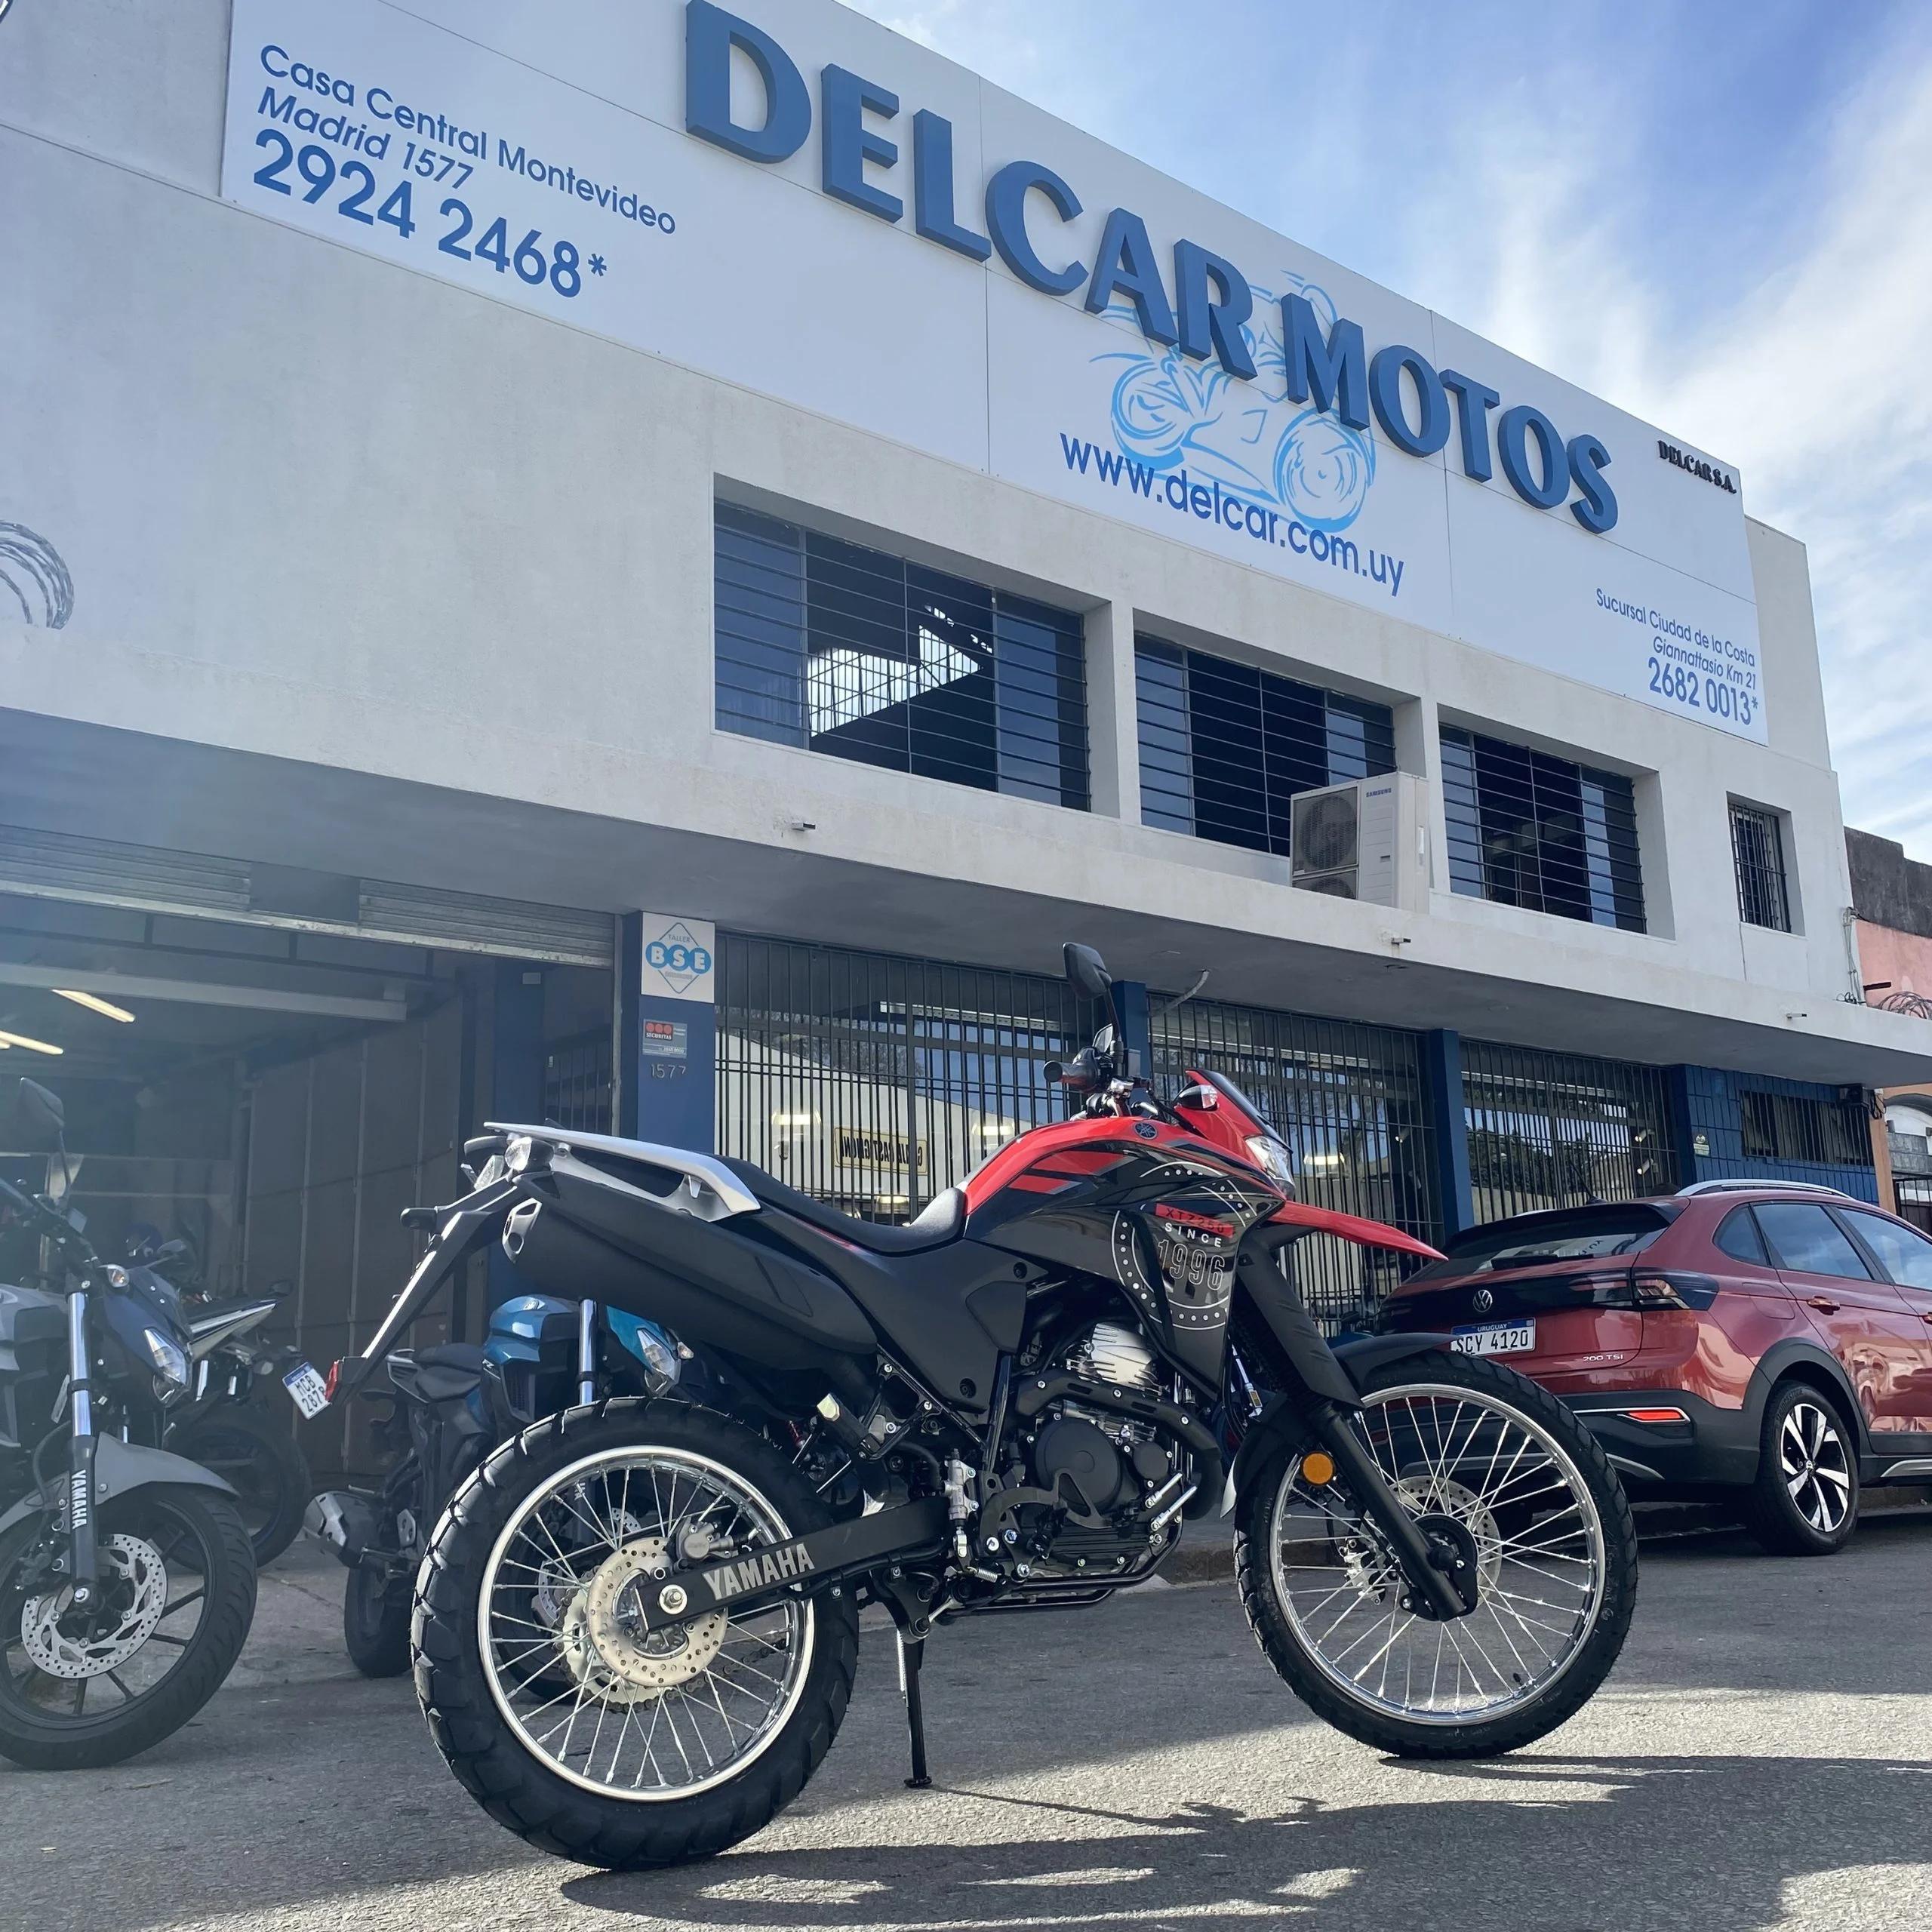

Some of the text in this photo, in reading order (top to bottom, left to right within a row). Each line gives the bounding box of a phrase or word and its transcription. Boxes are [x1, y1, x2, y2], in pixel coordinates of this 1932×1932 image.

[257, 85, 474, 190] Madrid 1577
[260, 44, 676, 235] Casa Central Montevideo
[253, 128, 416, 239] 2924
[686, 0, 1619, 534] DELCAR MOTOS
[1657, 440, 1737, 494] DELCAR S.A.
[1060, 432, 1404, 597] www.delcar.com.uy
[1596, 587, 1755, 667] Sucursal Ciudad de la Costa
[1647, 656, 1700, 708] 2682
[1653, 635, 1756, 691] Giannattasio Km 21
[651, 944, 706, 971] BSE
[668, 934, 691, 943] TALLER
[651, 1063, 687, 1079] 1577
[1164, 1222, 1222, 1247] SINCE
[1165, 1207, 1225, 1234] XTZ250
[1158, 1238, 1226, 1291] 1996
[1456, 1329, 1528, 1353] SCY 4120
[1477, 1323, 1508, 1332] URUGUAY
[71, 1469, 88, 1530] YAMAHA
[701, 1543, 816, 1601] YAMAHA
